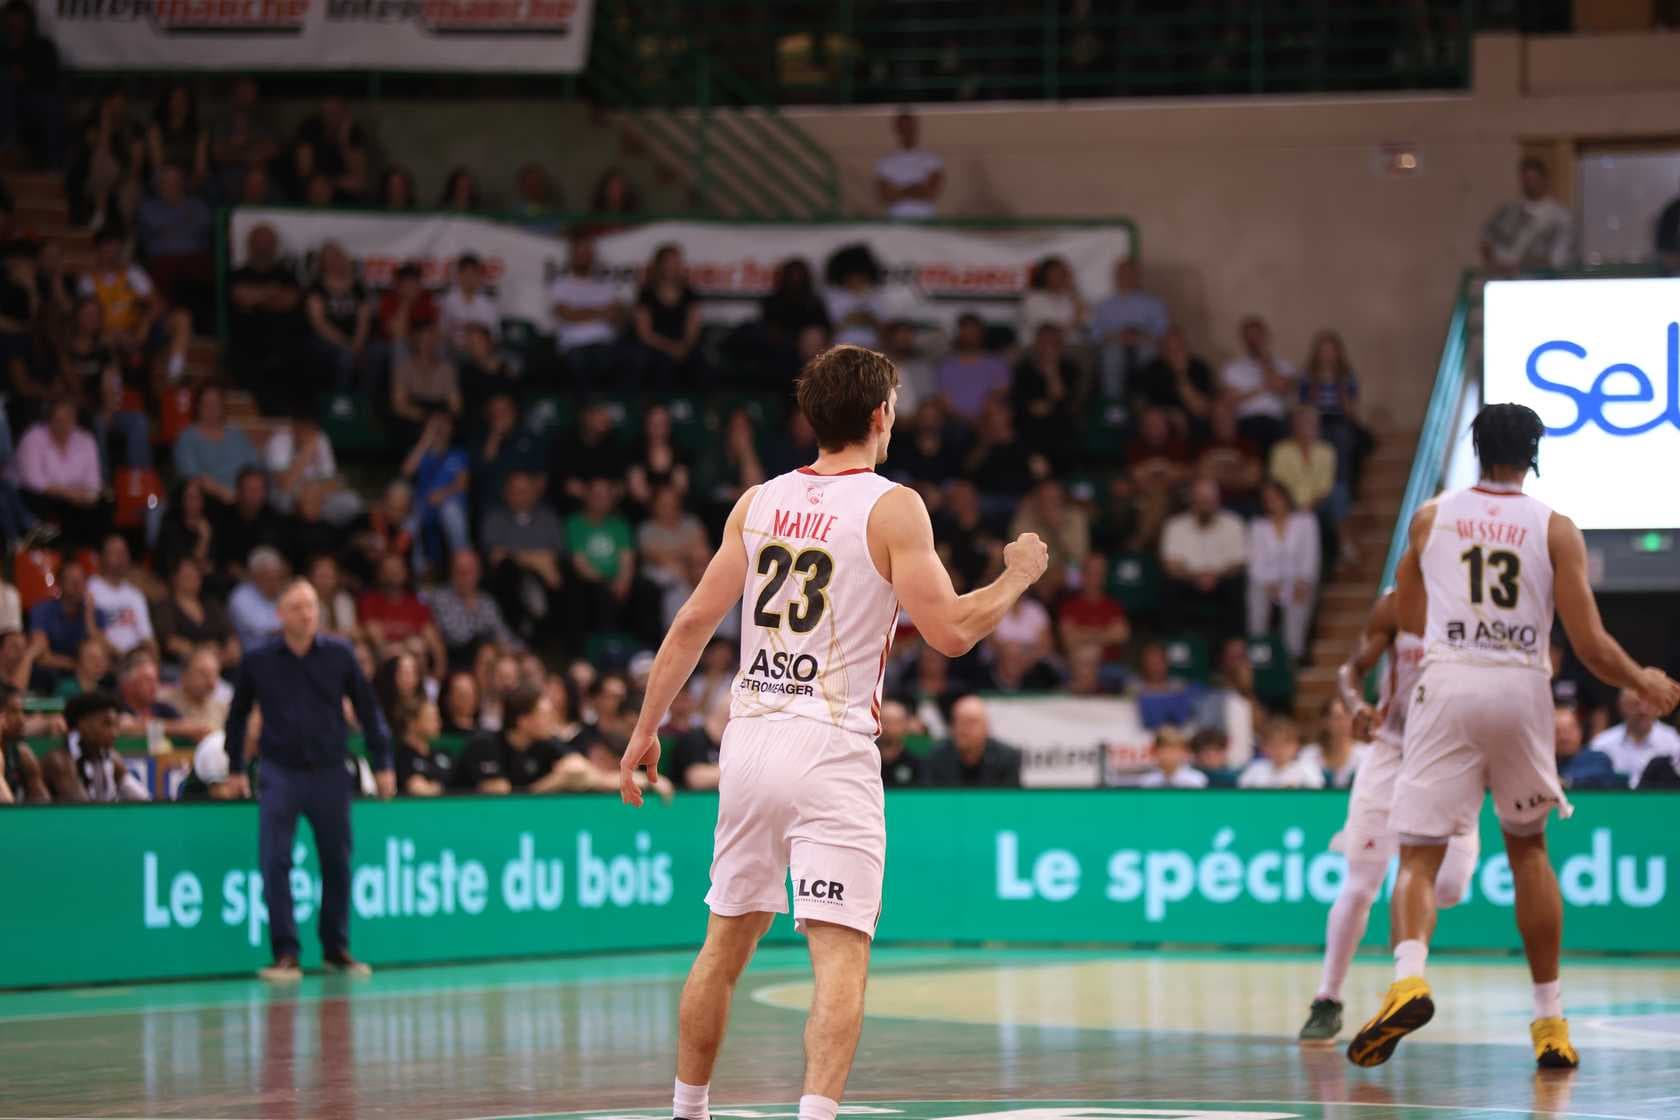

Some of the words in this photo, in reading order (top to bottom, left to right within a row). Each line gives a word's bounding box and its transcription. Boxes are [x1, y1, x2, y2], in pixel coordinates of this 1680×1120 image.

[753, 542, 834, 635] 23
[1461, 544, 1521, 610] 13
[143, 852, 203, 929] Le
[221, 836, 489, 947] spéaliste
[502, 832, 563, 913] du
[577, 830, 674, 908] bois
[798, 879, 844, 901] LCR
[996, 830, 1081, 901] Le
[1106, 828, 1516, 921] spéciae
[1559, 828, 1667, 908] du
